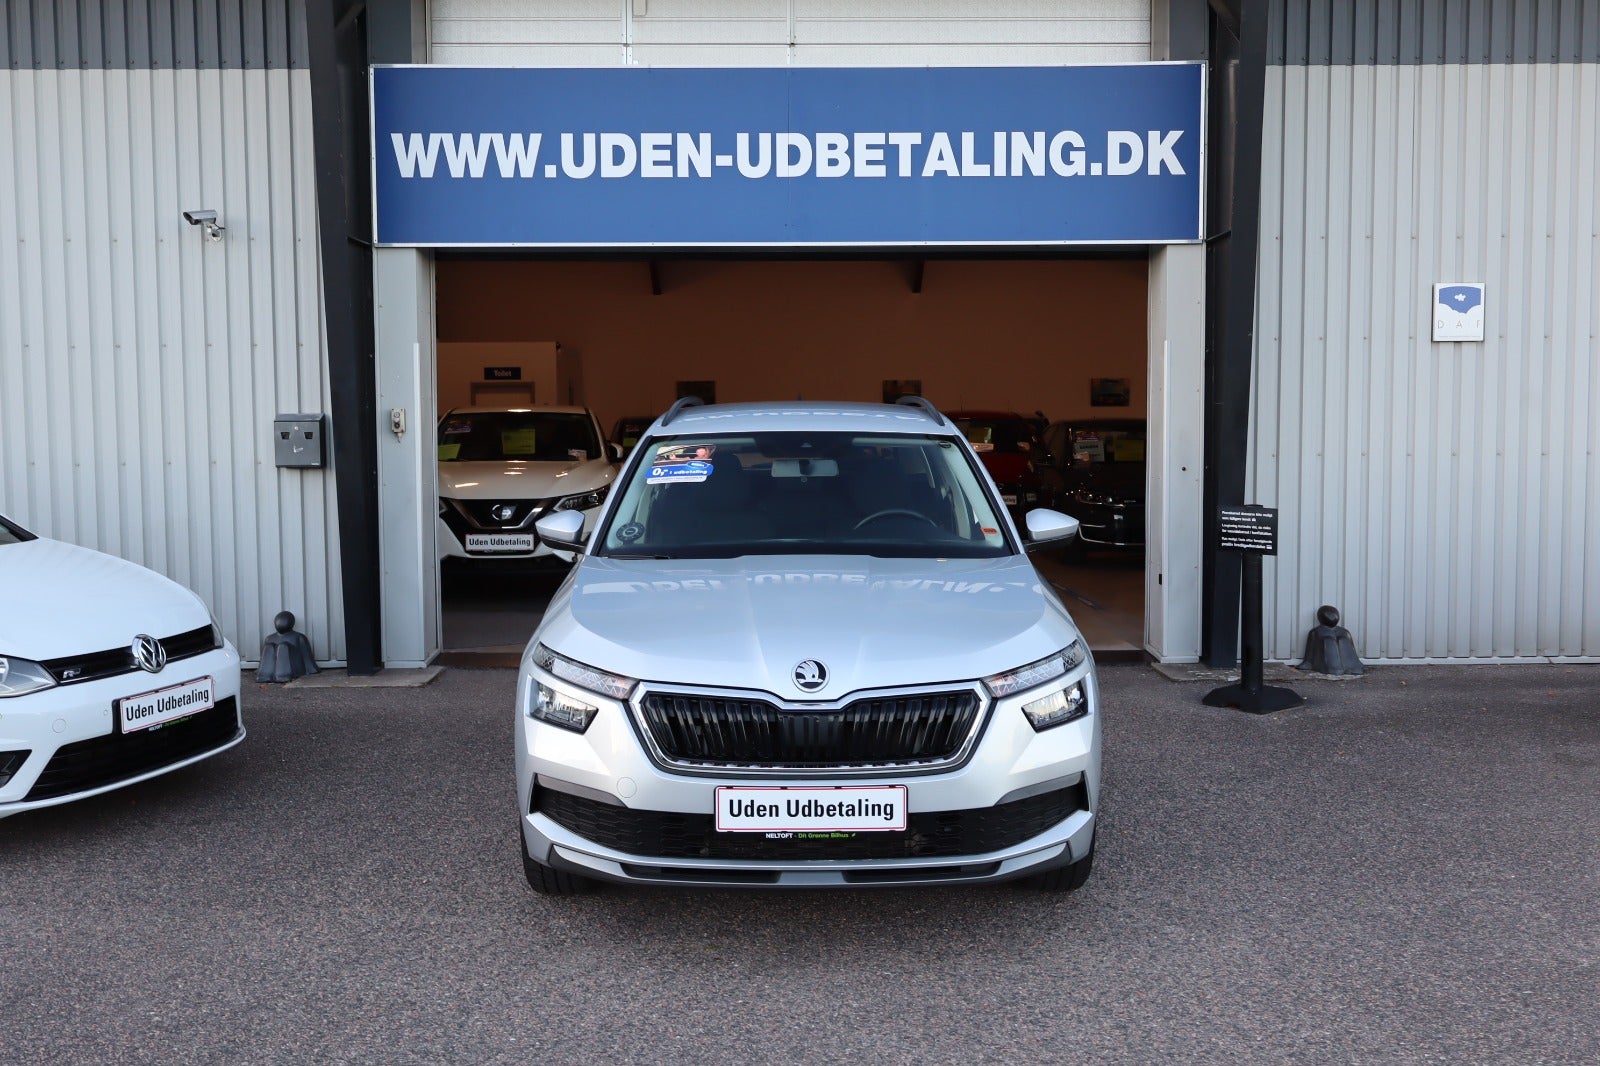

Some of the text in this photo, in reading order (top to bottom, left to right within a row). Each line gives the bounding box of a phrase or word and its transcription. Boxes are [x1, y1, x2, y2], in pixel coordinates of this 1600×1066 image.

[390, 129, 1186, 180] WWW.UDEN-UDBETALING.DK
[493, 369, 512, 377] Toilet
[469, 538, 531, 547] Uden Udbetaling
[126, 704, 154, 722] Uden
[157, 688, 209, 713] Udbetaling
[729, 798, 894, 821] Uden Udbetaling
